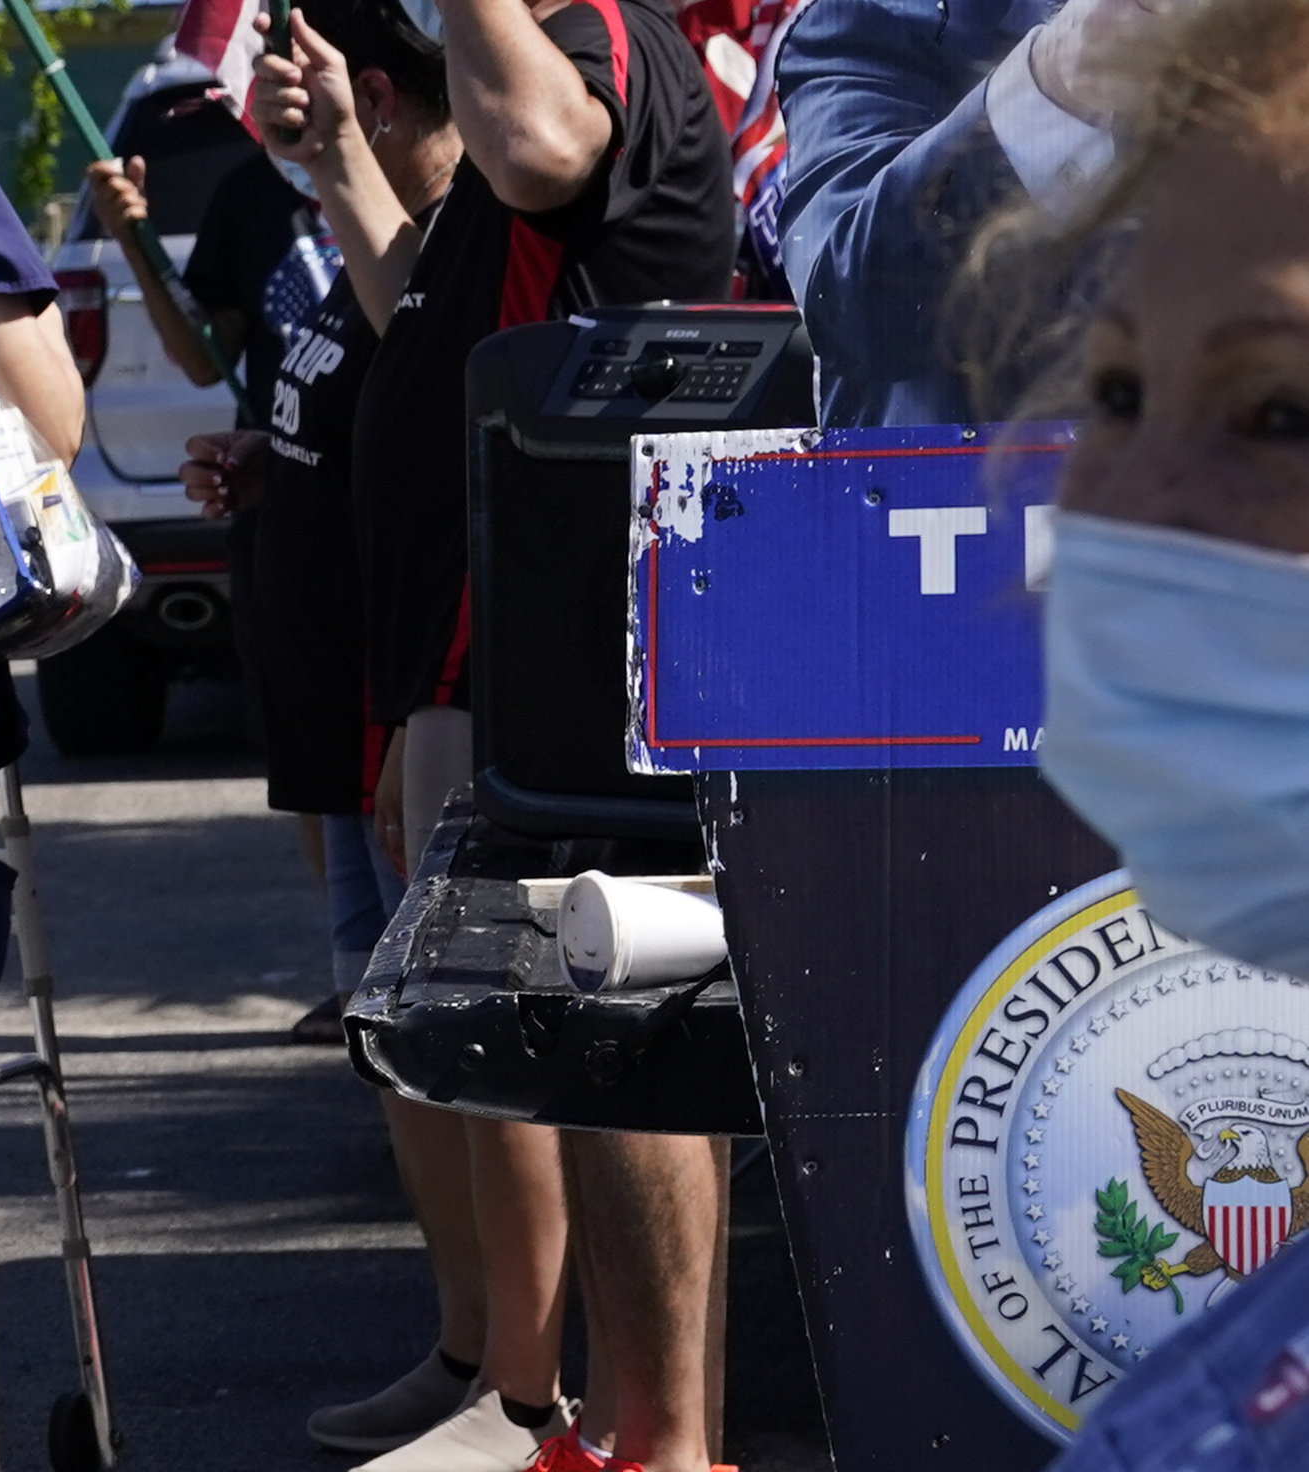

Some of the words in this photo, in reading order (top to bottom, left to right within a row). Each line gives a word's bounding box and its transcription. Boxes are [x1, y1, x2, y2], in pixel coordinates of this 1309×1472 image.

[950, 908, 1190, 1155] PRESIDEN
[1186, 1110, 1199, 1123] E
[1197, 1100, 1266, 1116] PLURIBUS
[1268, 1106, 1309, 1121] UNUM
[959, 1174, 1001, 1260] THE
[981, 1270, 1029, 1321] OF
